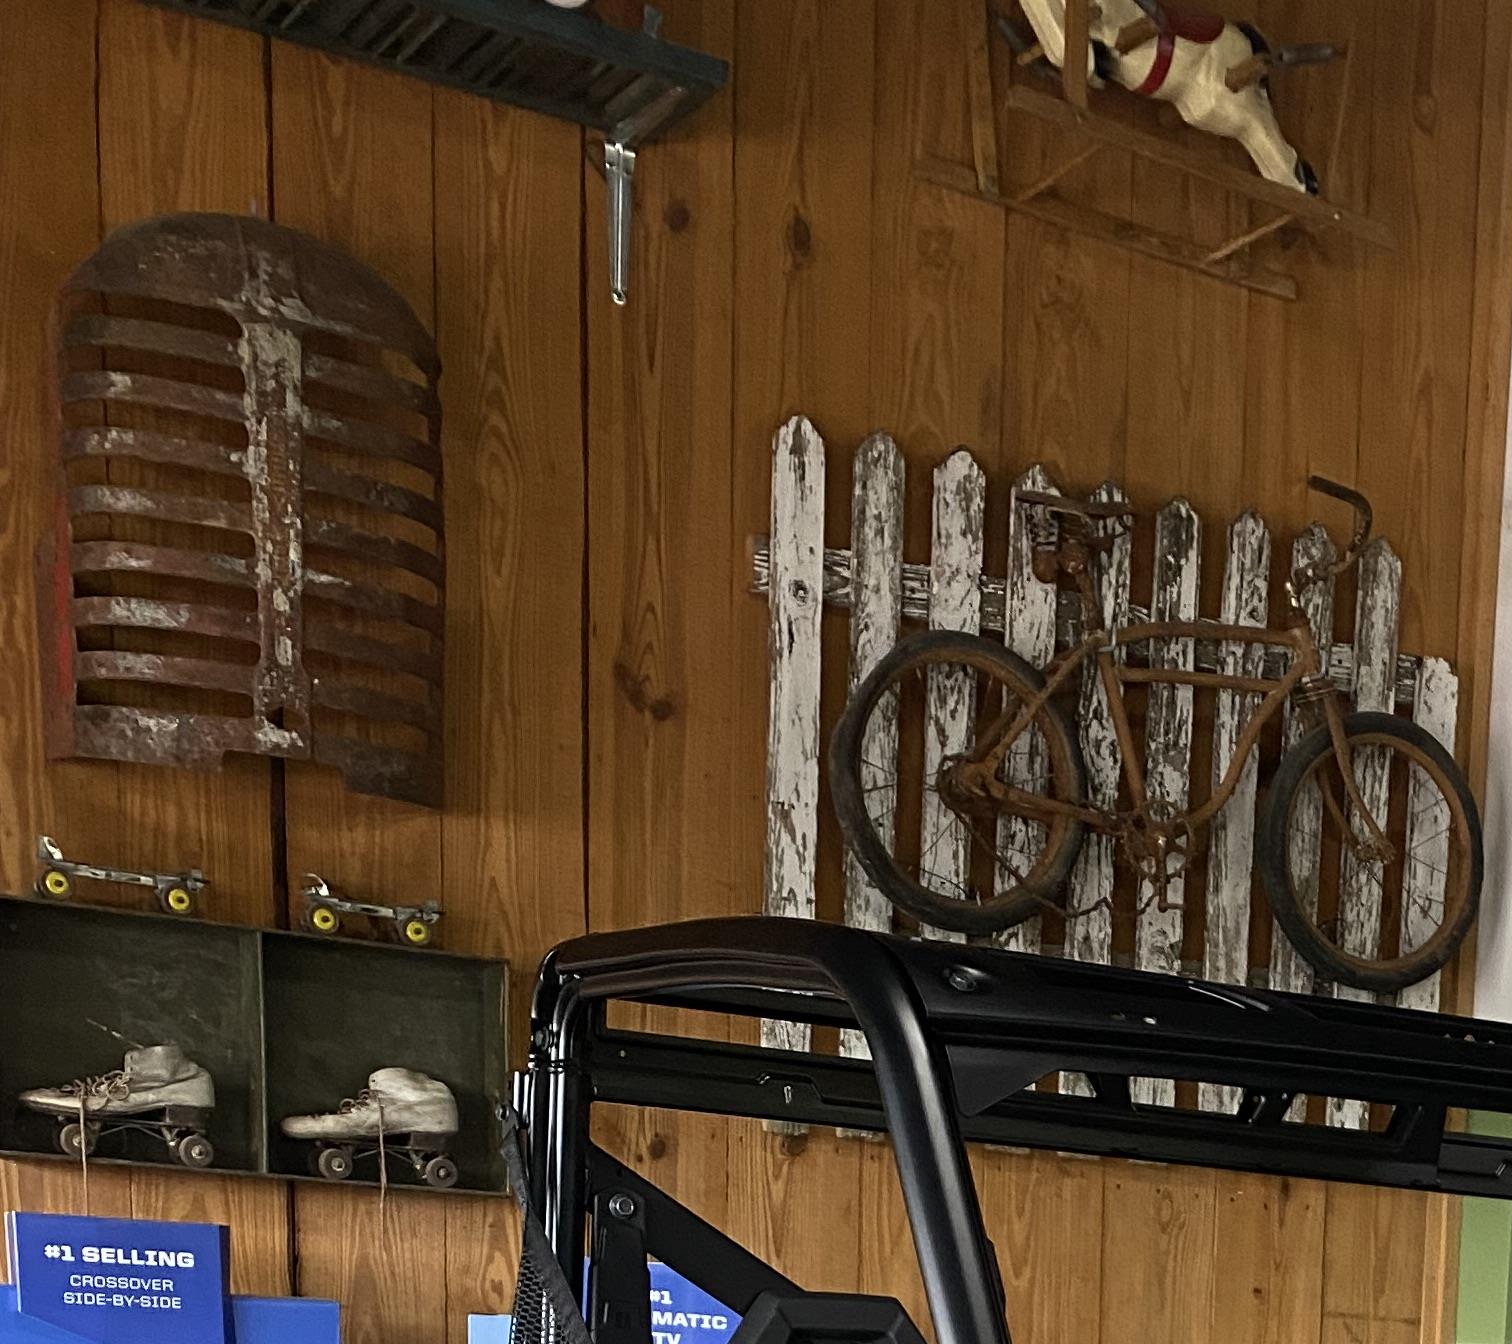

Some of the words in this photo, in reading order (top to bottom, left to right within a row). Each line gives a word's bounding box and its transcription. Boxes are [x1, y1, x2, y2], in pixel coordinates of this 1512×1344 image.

[44, 1244, 75, 1263] #1
[82, 1246, 195, 1268] SELLING
[69, 1274, 174, 1292] CROSSOVER
[63, 1292, 182, 1310] SIDE-BY-SIDE
[652, 1310, 728, 1330] MATIC
